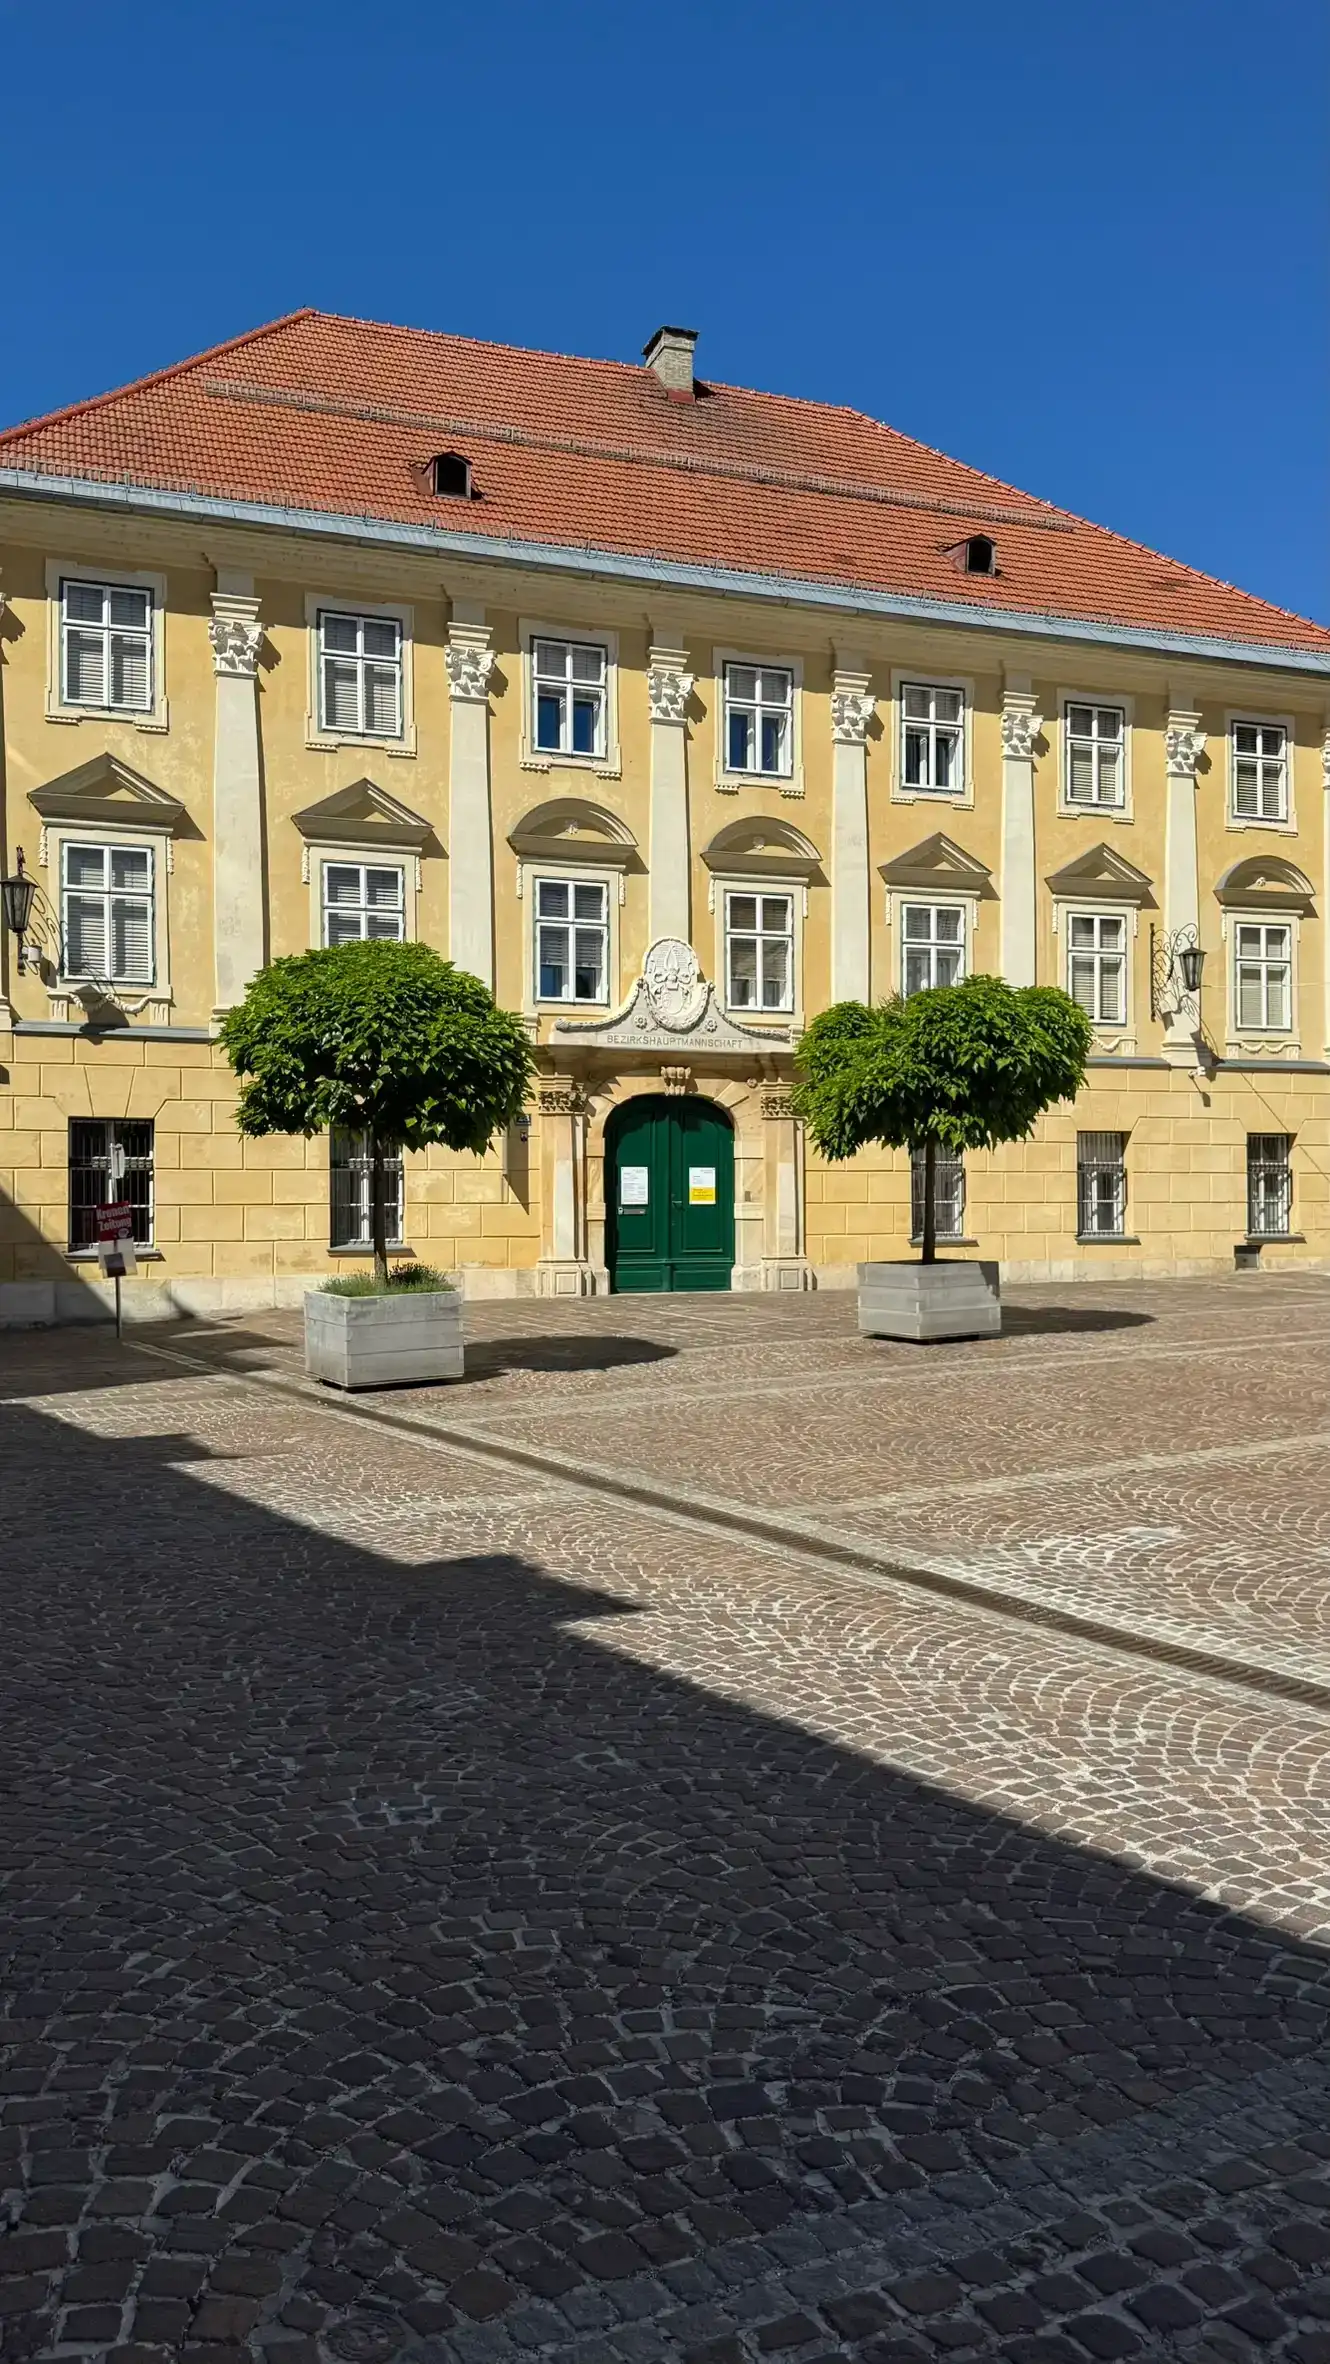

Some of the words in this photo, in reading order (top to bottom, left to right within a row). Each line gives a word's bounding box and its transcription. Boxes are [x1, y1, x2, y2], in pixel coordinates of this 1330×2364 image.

[607, 1034, 743, 1049] BEZIRKSHAUPTMANNSCHAFT
[96, 1206, 130, 1220] Kronen
[97, 1218, 132, 1232] Zeitung
